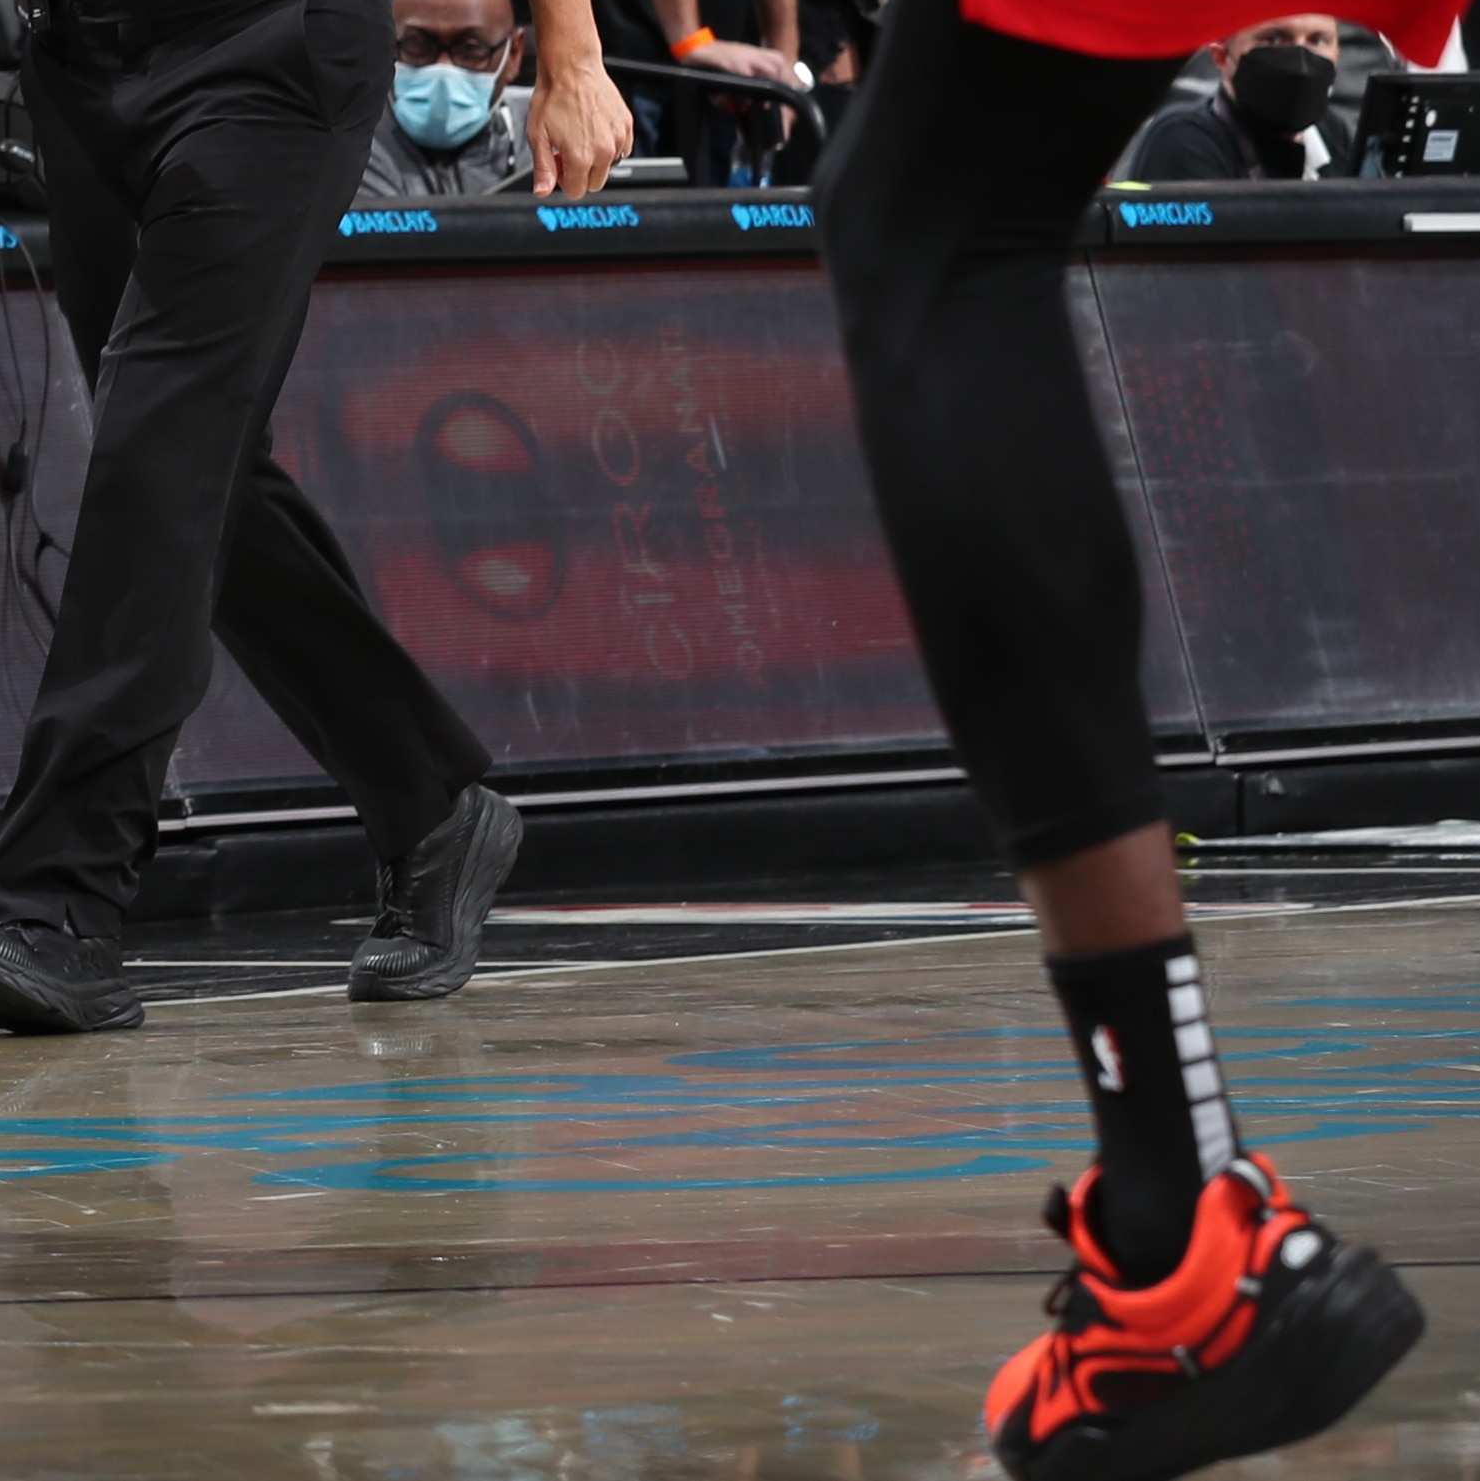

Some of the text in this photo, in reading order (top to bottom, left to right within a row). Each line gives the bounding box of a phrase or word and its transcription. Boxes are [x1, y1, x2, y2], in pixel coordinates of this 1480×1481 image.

[352, 209, 438, 234] BARCLAYS
[555, 204, 640, 230] BARCLAYS
[1136, 201, 1214, 226] BARCLAYS
